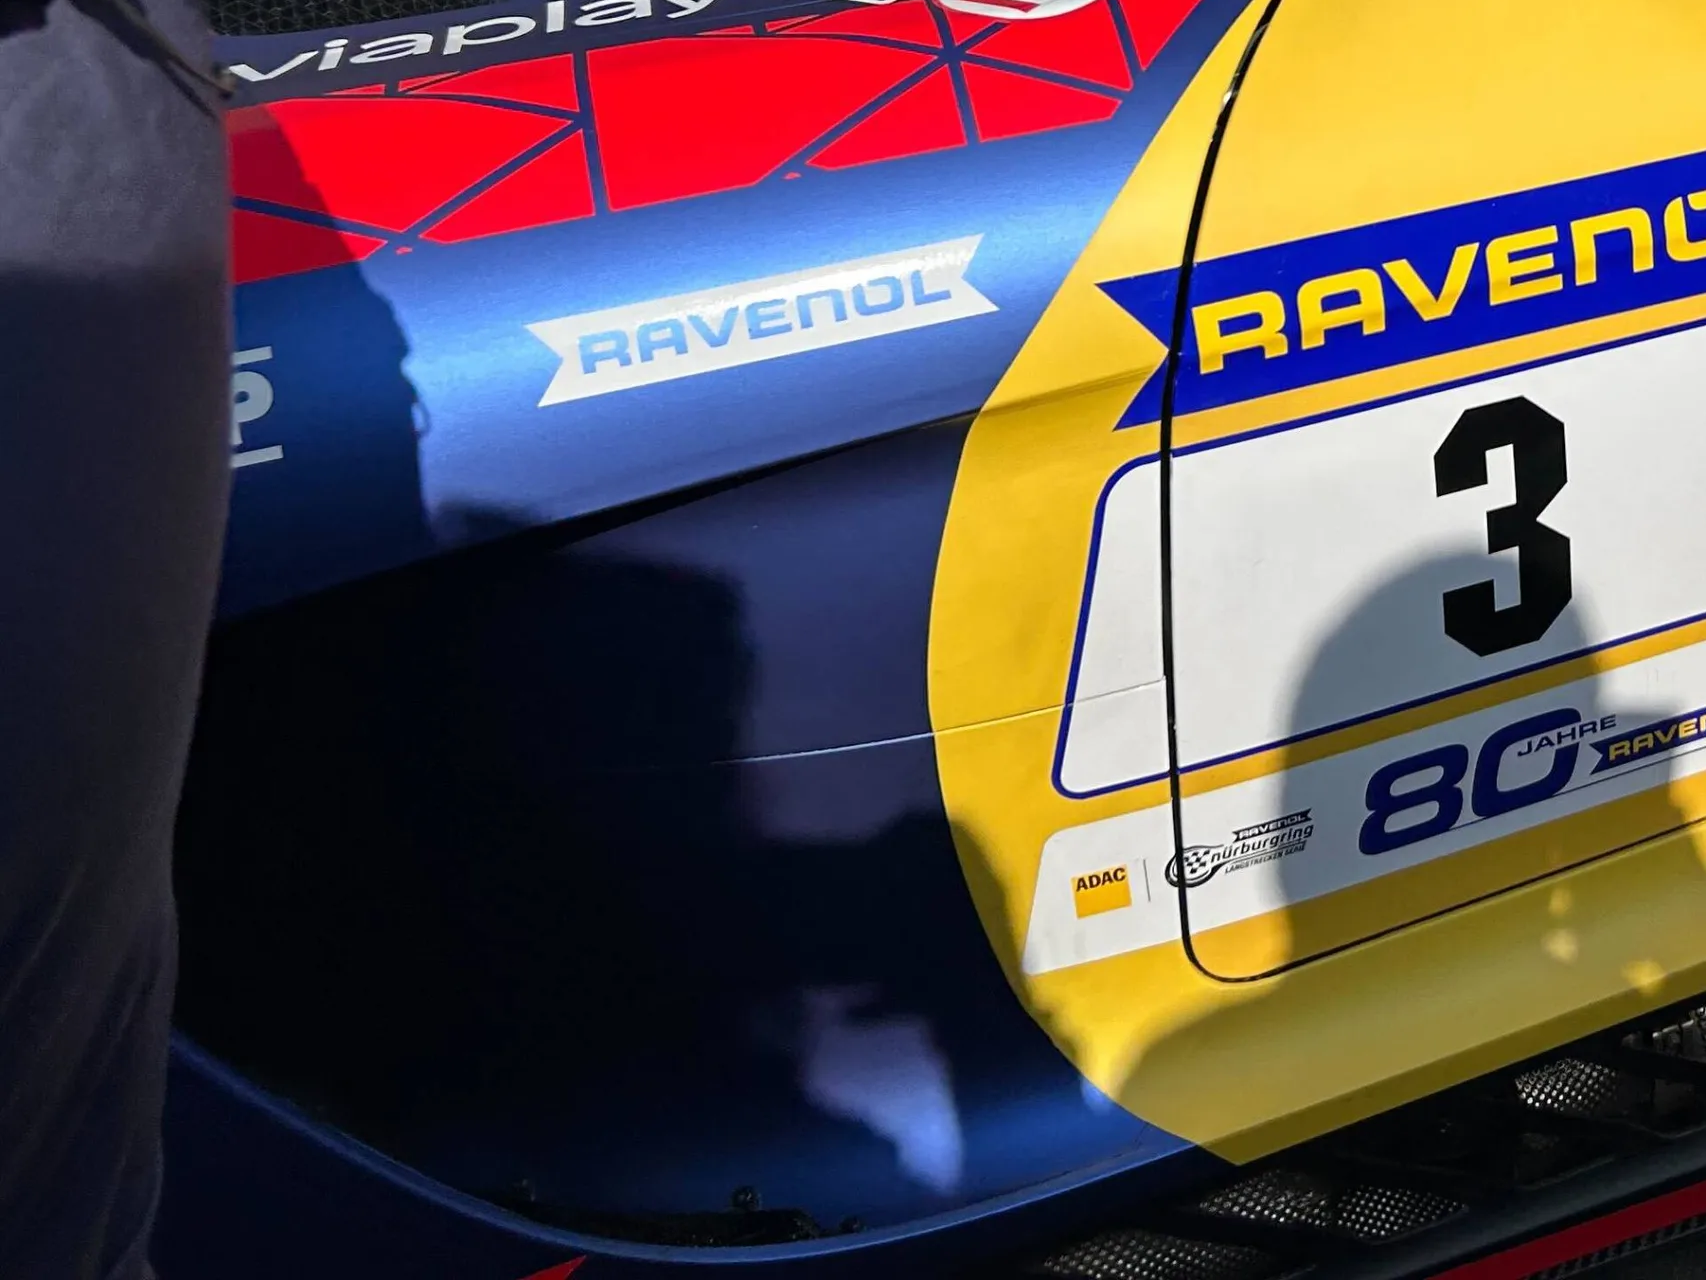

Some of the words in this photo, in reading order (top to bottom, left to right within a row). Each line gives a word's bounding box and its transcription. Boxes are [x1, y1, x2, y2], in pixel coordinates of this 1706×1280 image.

[576, 268, 953, 375] RAVENOL
[1434, 395, 1573, 657] 3
[1517, 713, 1617, 757] JAHRE
[1358, 706, 1583, 857] 80
[1211, 823, 1315, 864] nürburgring
[1238, 814, 1306, 840] RAVENOL
[1075, 865, 1127, 892] ADAC
